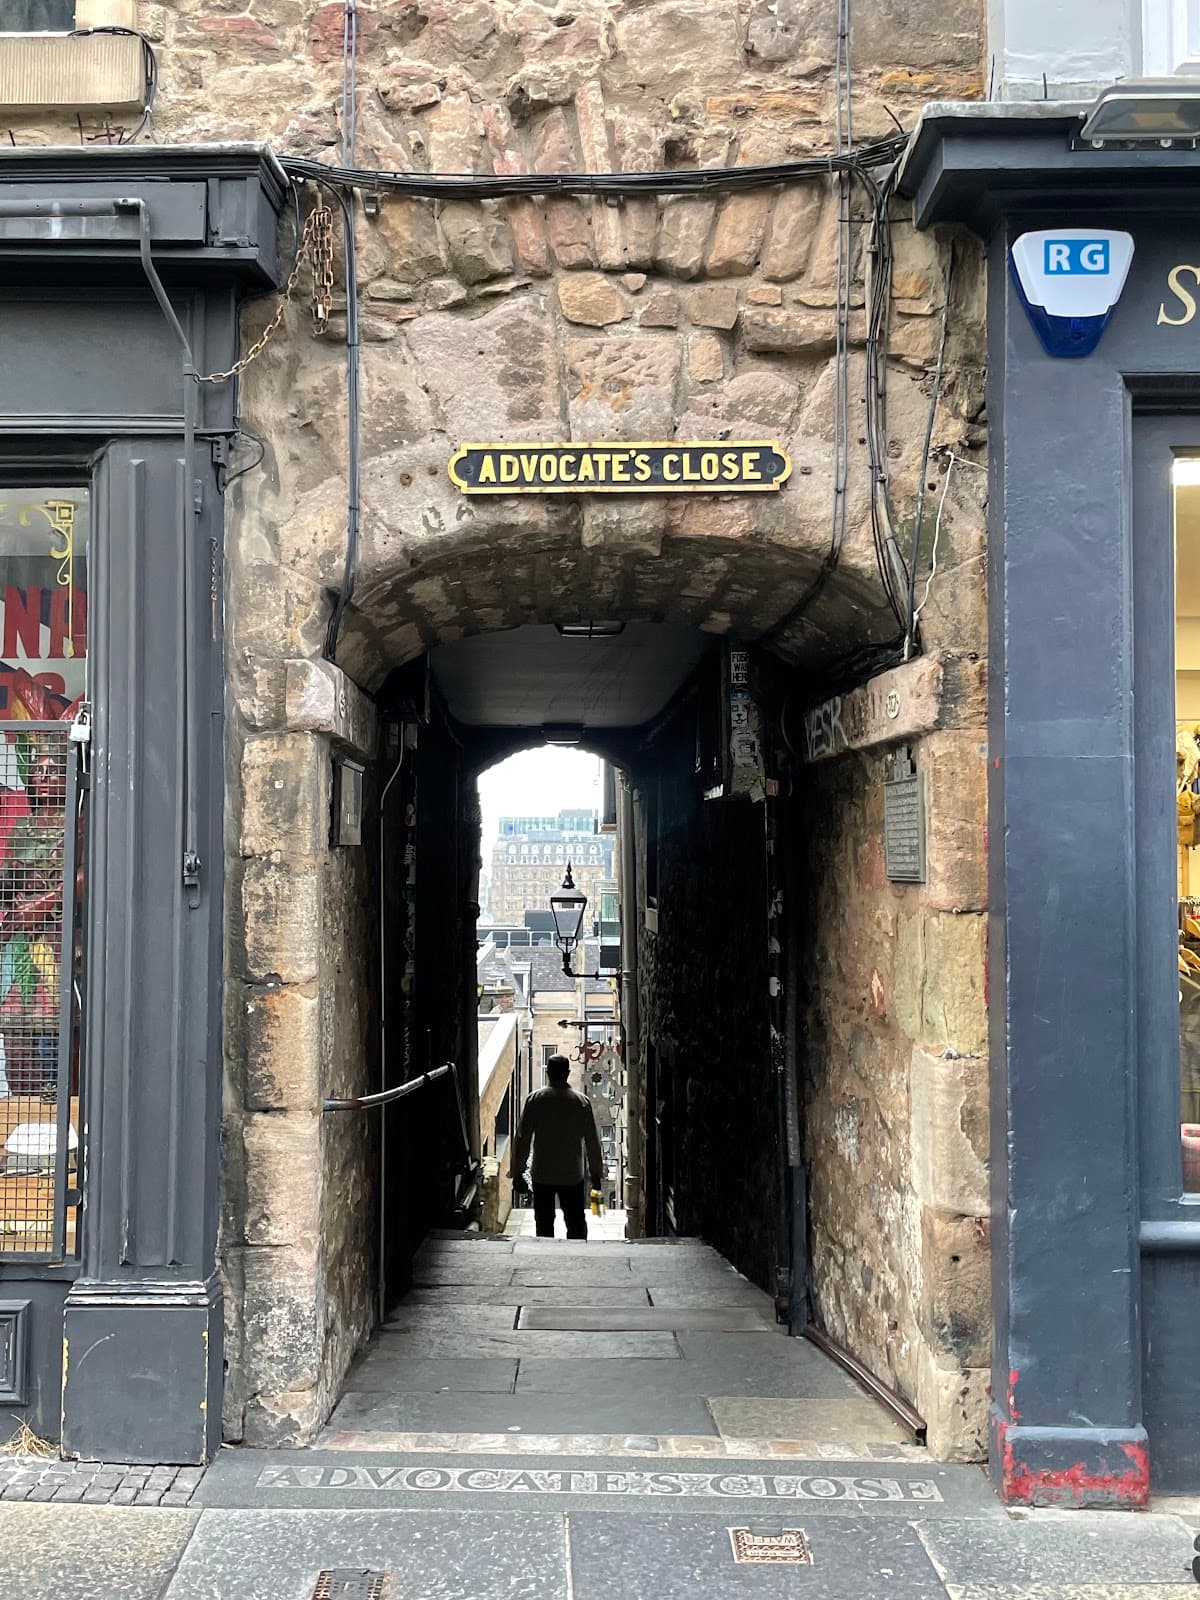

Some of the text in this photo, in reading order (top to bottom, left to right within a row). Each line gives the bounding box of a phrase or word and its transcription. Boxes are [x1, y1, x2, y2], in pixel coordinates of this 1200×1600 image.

[478, 449, 762, 483] ADVOCATE'S CLOSE
[262, 1466, 944, 1500] ADVOCATE'S CLOSE
